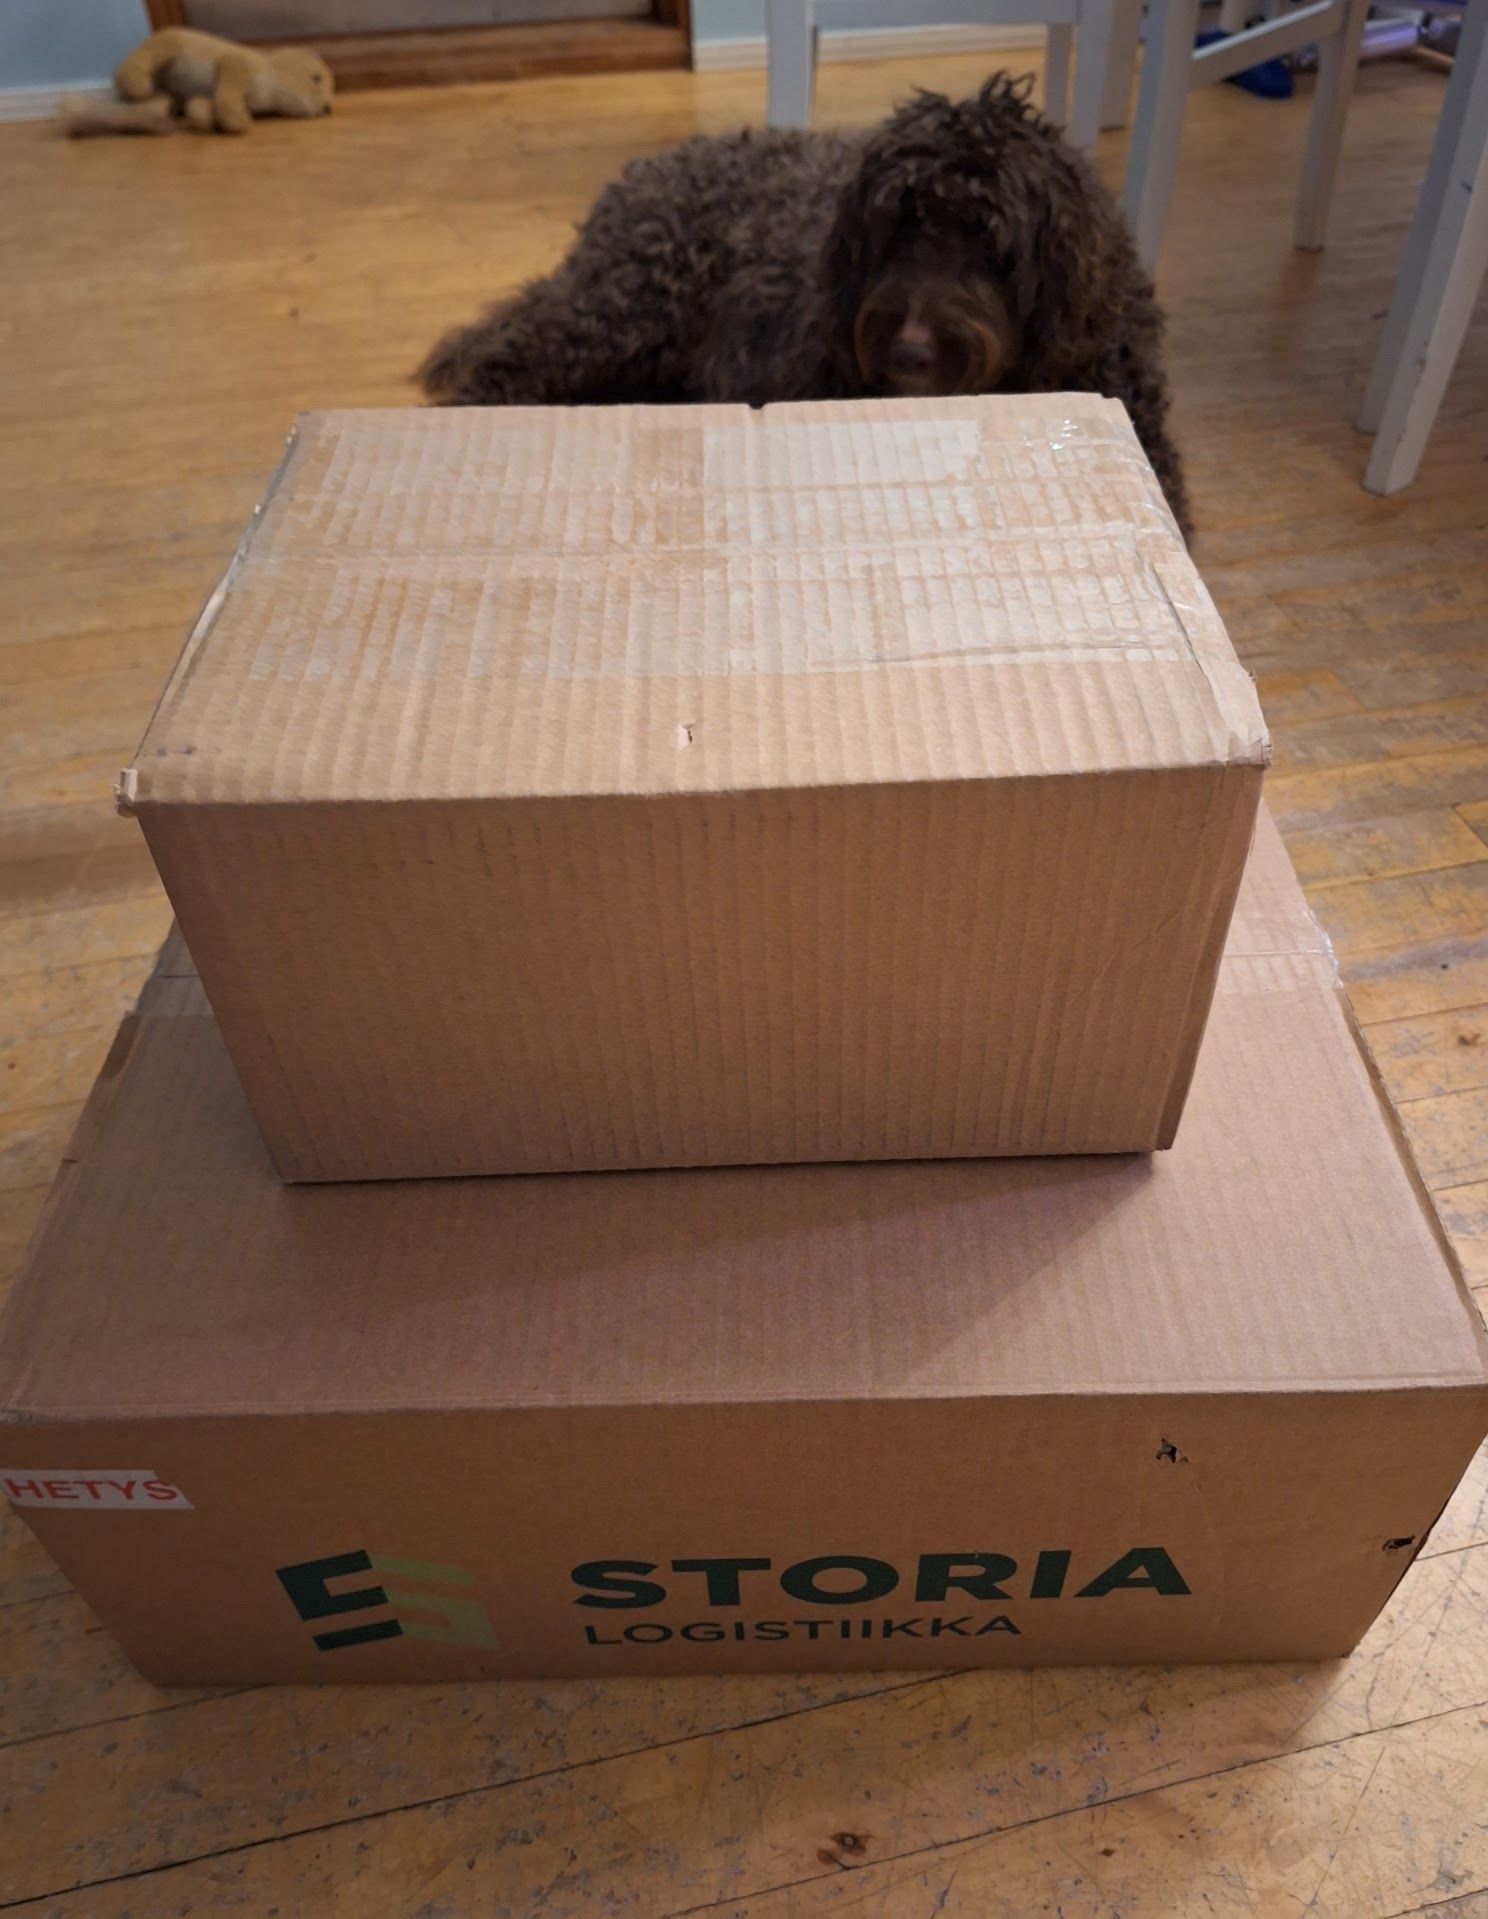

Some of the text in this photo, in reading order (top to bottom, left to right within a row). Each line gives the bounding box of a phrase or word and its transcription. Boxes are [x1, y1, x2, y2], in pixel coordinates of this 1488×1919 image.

[3, 1479, 178, 1500] HETYS
[571, 1547, 1192, 1609] STORIA
[585, 1615, 1022, 1646] LOGISTIIKKA
